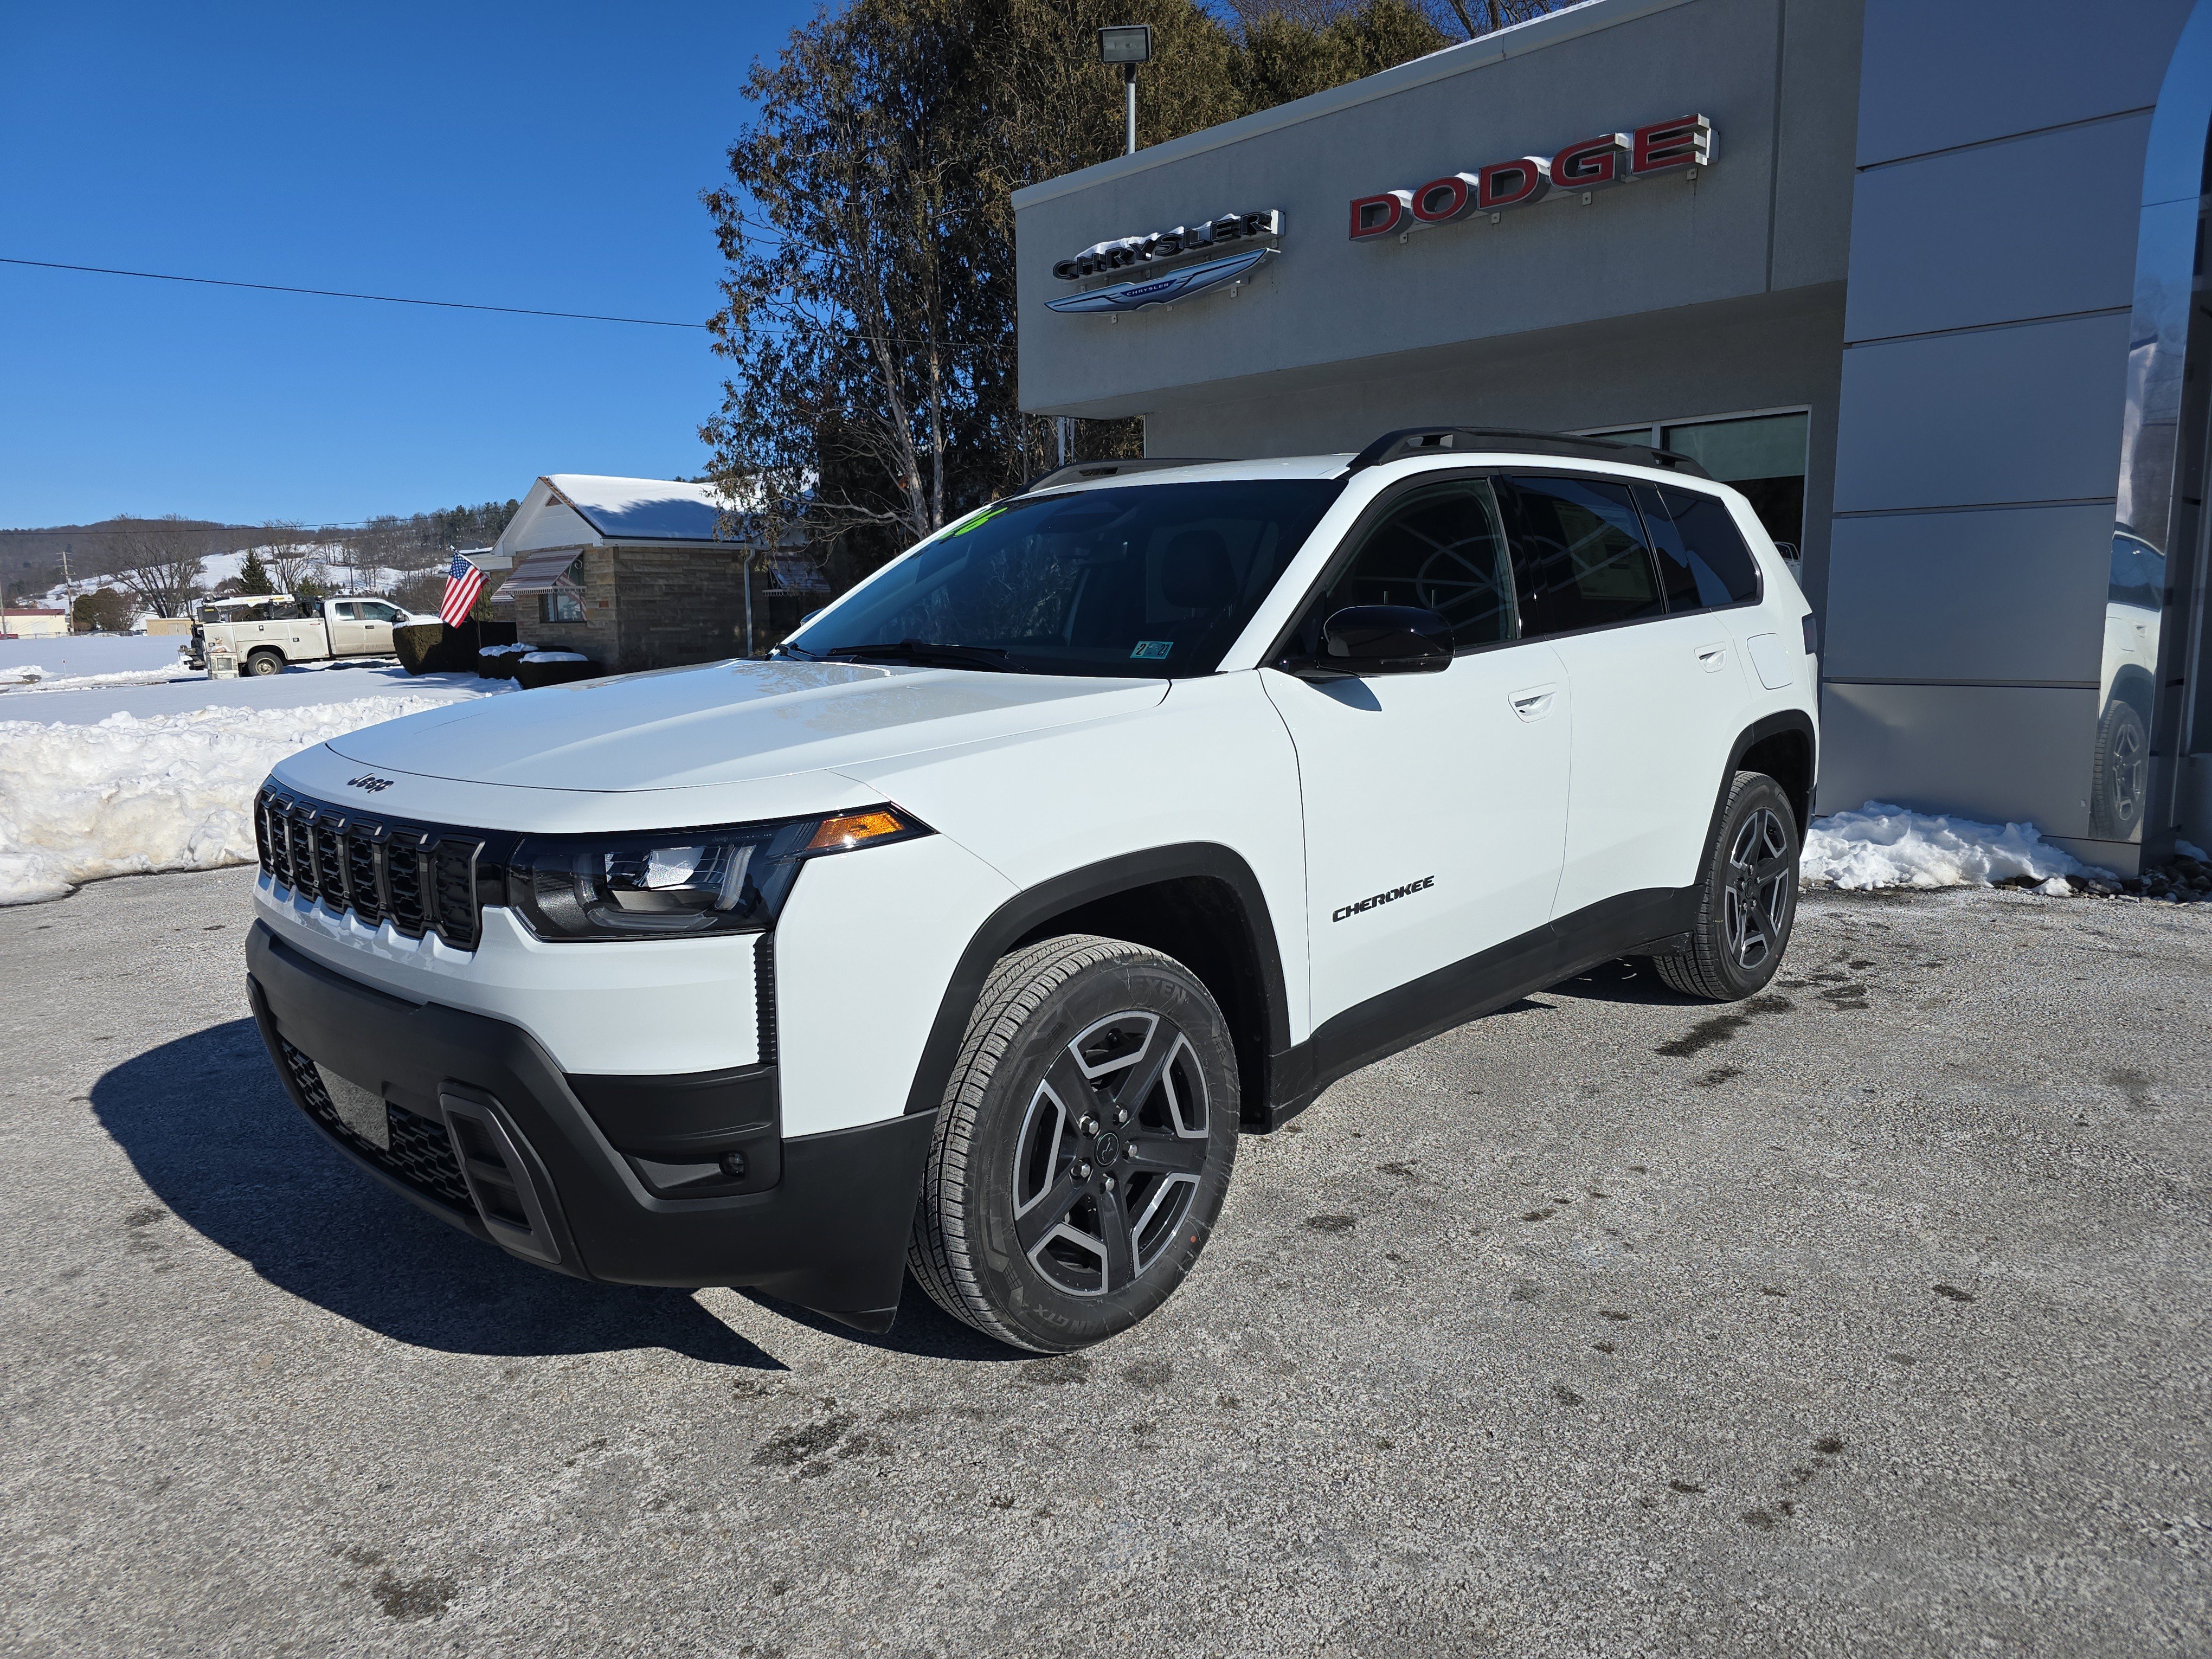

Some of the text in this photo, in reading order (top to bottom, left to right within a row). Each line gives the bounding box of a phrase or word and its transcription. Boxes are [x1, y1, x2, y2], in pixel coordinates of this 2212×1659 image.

[1349, 113, 1703, 242] DODGE
[1053, 211, 1273, 280] CHRYSLER
[1127, 282, 1169, 296] CHRYSLER
[346, 773, 394, 794] Jeep
[1332, 875, 1435, 923] CHEROKEE
